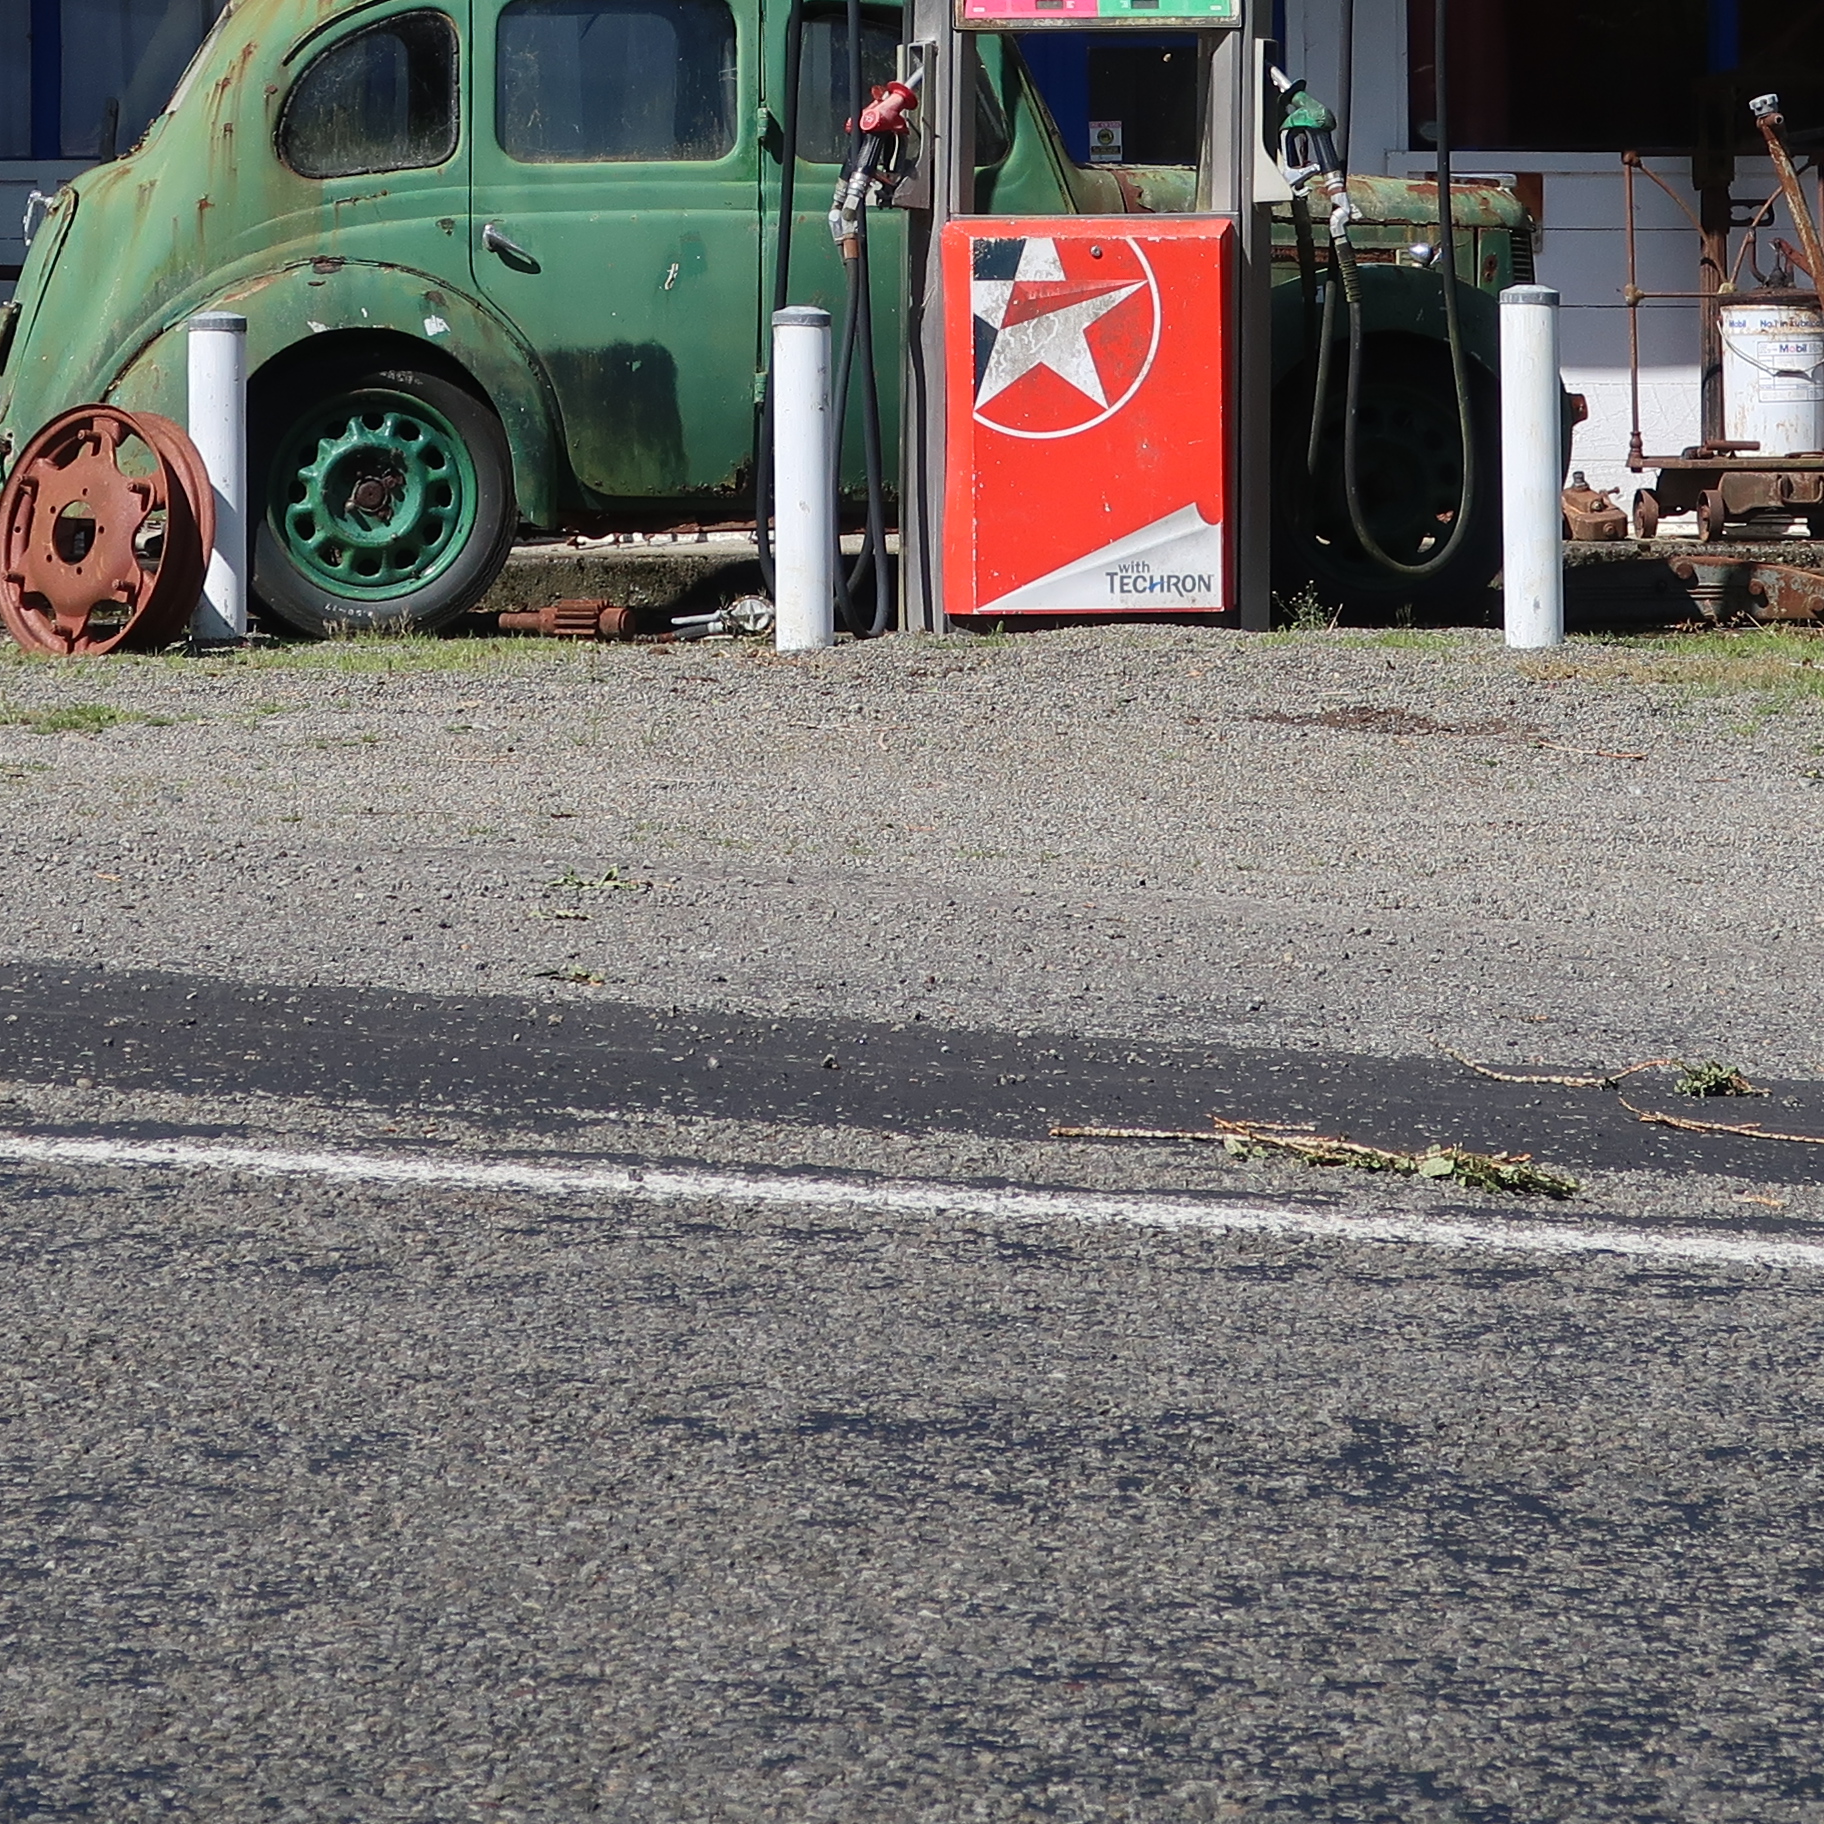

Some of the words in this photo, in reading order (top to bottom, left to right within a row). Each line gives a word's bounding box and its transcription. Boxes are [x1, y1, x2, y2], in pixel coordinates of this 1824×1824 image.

[1728, 319, 1747, 328] Mobil
[1779, 344, 1807, 354] Mobil
[1118, 560, 1151, 574] with
[1105, 571, 1212, 598] TECHRON
